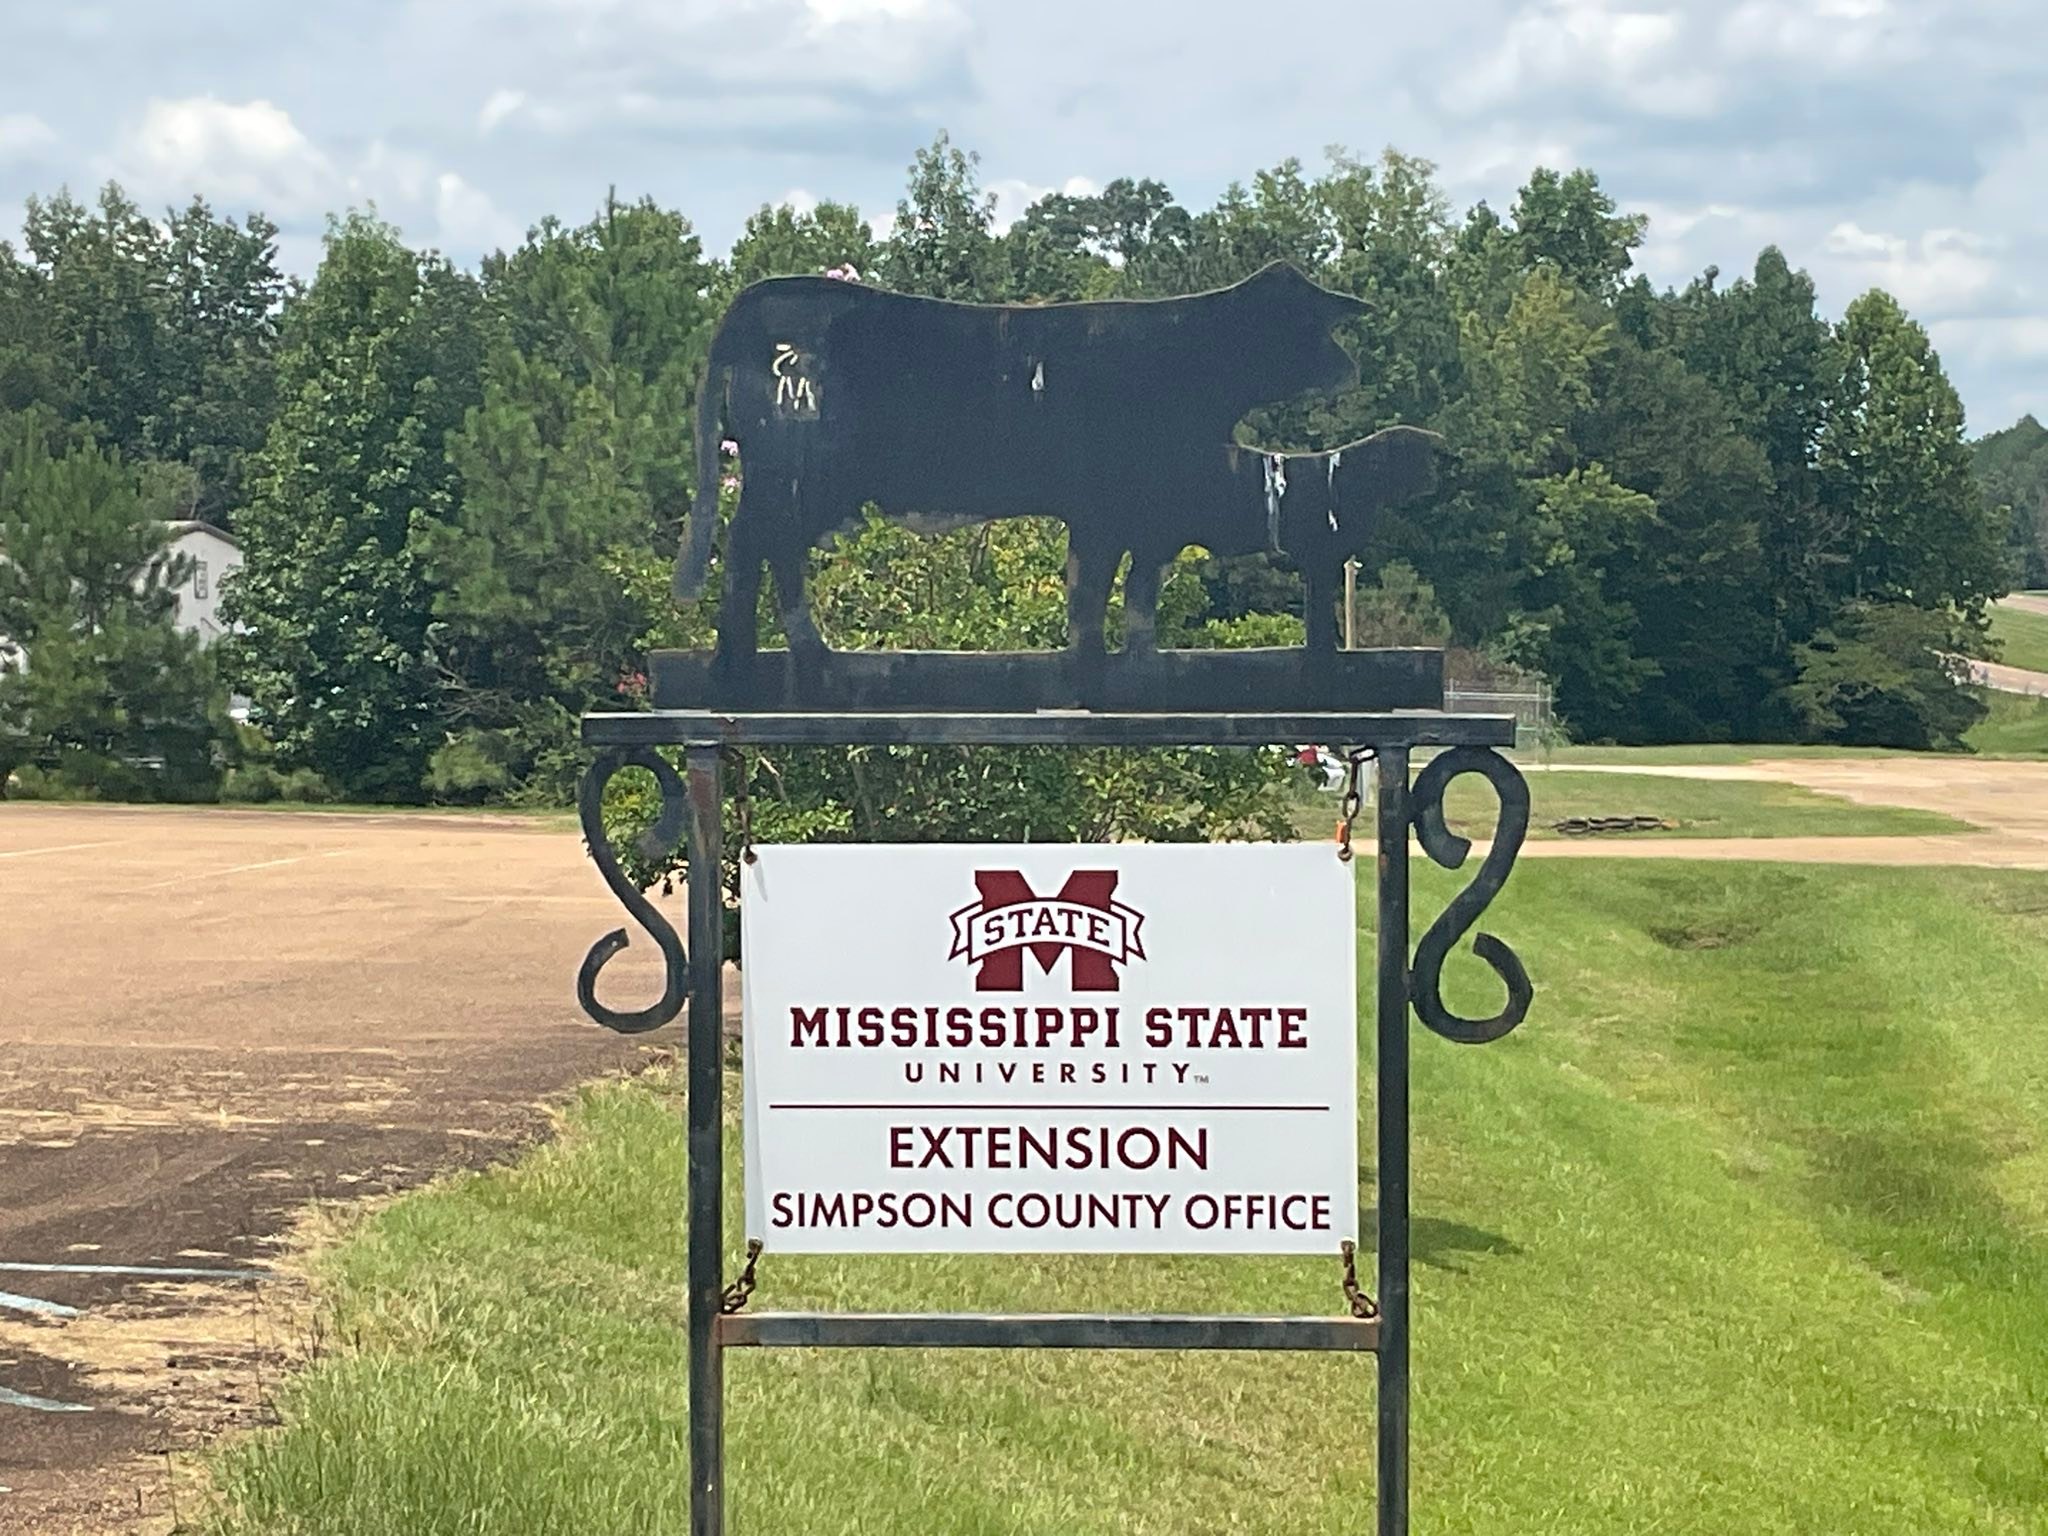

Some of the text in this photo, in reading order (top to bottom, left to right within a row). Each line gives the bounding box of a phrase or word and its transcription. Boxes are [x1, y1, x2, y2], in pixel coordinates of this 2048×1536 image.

[974, 869, 1120, 992] M
[983, 906, 1111, 948] STATE
[790, 1007, 1308, 1049] MISSISSIPPI STATE
[905, 1062, 1190, 1084] UNIVERSITY
[890, 1126, 1208, 1171] EXTENSION
[771, 1192, 1331, 1231] SIMPSON COUNTY OFFICE
